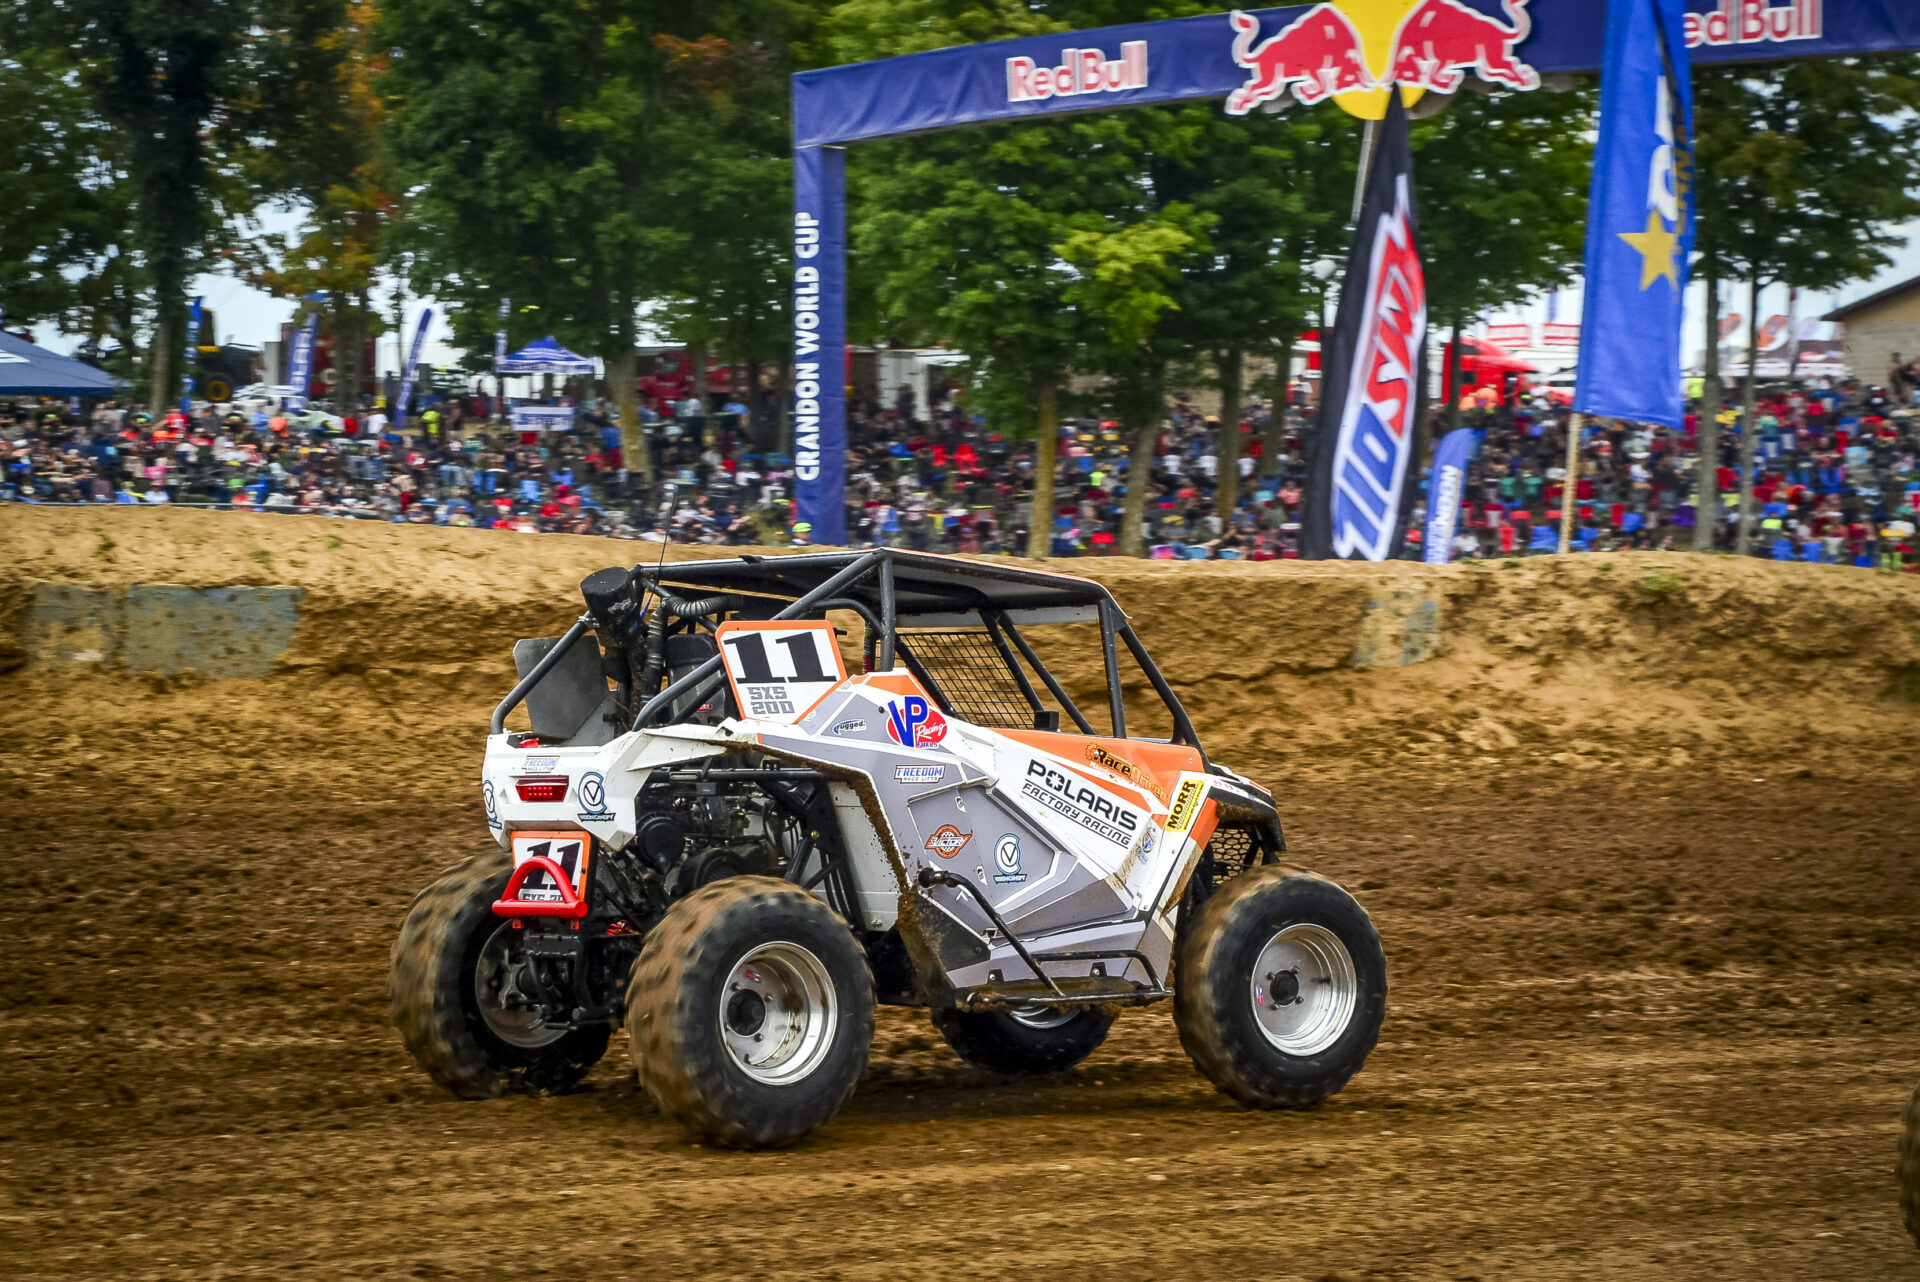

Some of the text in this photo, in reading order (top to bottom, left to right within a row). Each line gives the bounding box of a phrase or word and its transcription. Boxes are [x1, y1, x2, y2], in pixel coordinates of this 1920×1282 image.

[1683, 0, 1735, 48] ed
[1007, 40, 1148, 102] Red Bull
[795, 211, 820, 481] CRANDON WORLD CUP
[723, 631, 838, 684] 11
[750, 701, 795, 715] 200
[887, 696, 928, 748] VP
[915, 722, 947, 741] Racing
[897, 767, 943, 777] FREEDOM
[1027, 759, 1138, 832] POLARIS
[1022, 783, 1080, 819] FACTORY
[1082, 817, 1133, 846] RACING
[1167, 780, 1196, 830] MORR
